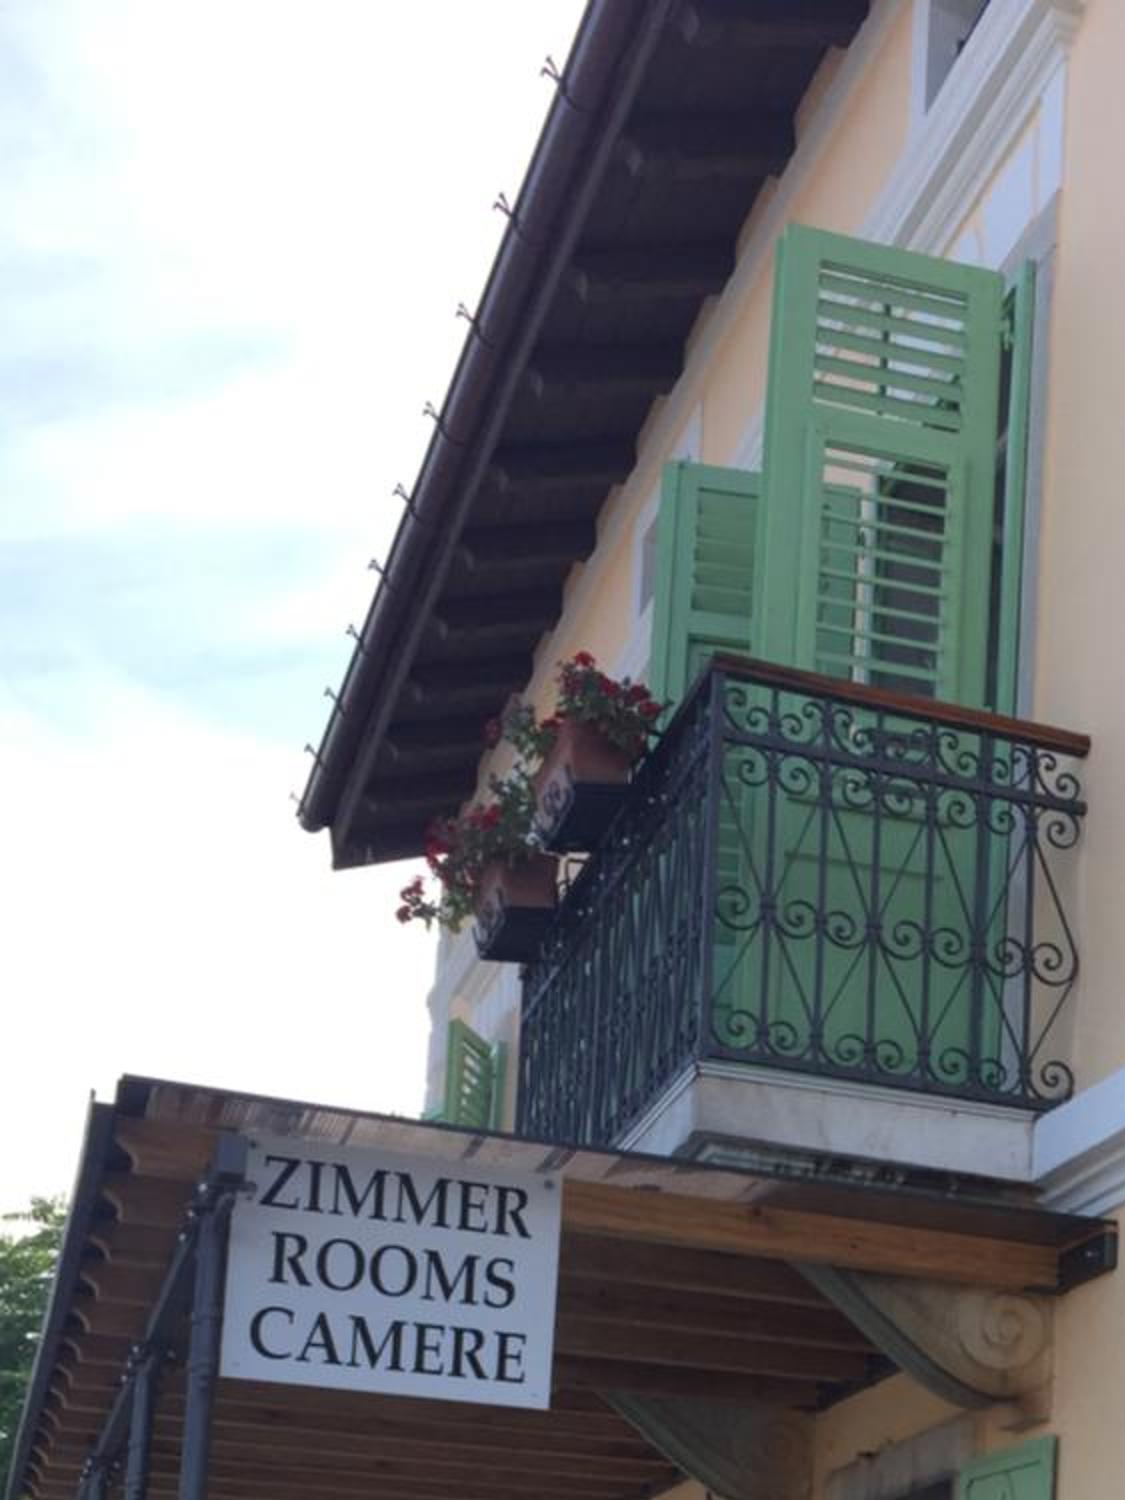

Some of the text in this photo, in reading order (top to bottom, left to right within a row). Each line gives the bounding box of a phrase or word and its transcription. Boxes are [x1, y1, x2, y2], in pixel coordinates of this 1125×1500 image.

[259, 1154, 532, 1239] ZIMMER
[267, 1231, 517, 1309] ROOMS
[249, 1306, 527, 1384] CAMERE
